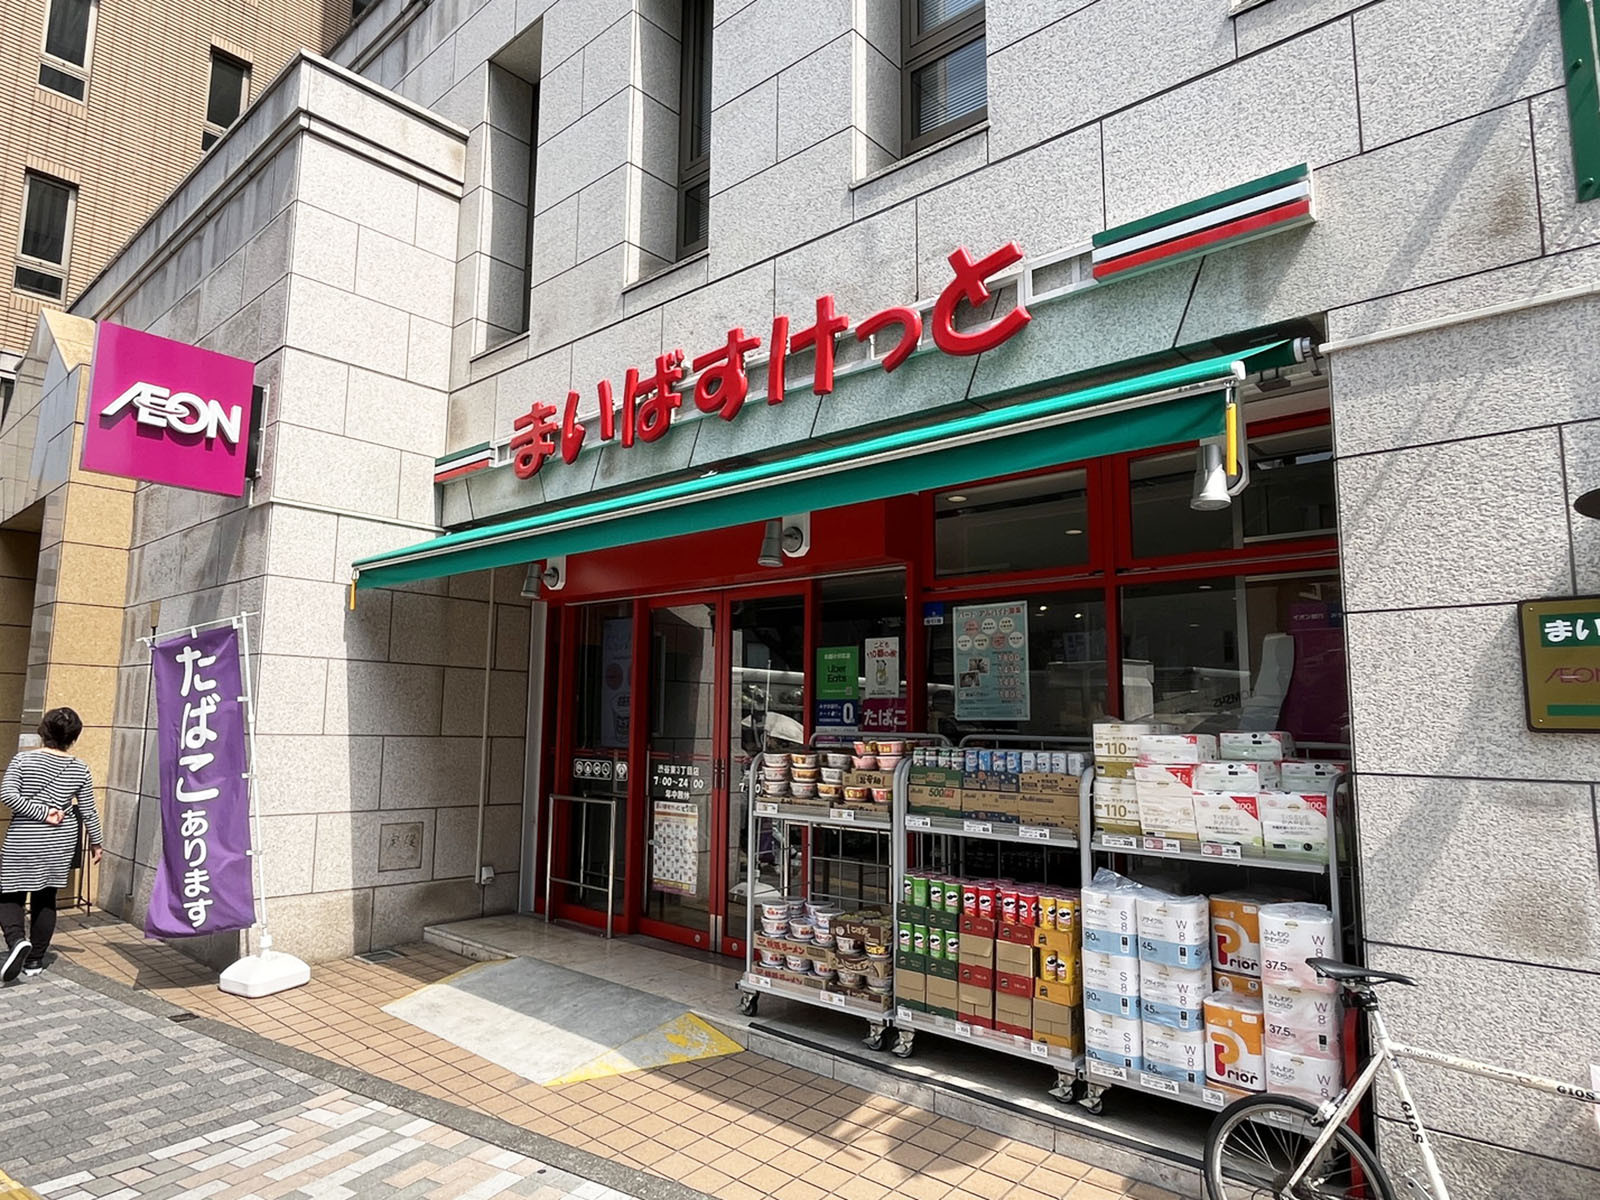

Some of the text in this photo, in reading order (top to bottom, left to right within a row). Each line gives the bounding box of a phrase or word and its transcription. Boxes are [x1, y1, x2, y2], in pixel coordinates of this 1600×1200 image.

[509, 241, 1031, 479] まいばすけっと
[101, 381, 242, 443] AEON
[827, 665, 846, 673] Uber
[864, 708, 907, 726] たばこ
[1104, 742, 1127, 755] 110
[1104, 804, 1127, 817] 110
[1120, 910, 1128, 921] S
[1121, 922, 1128, 931] 8
[1175, 920, 1187, 930] W
[1178, 932, 1186, 941] 8
[1311, 935, 1325, 946] W
[1316, 948, 1324, 959] 8
[1120, 971, 1128, 982] S
[1120, 983, 1128, 992] 8
[1177, 984, 1189, 993] W
[1179, 995, 1187, 1005] 8
[1314, 1002, 1328, 1013] W
[1318, 1015, 1326, 1025] 8
[1123, 1032, 1132, 1043] S
[1124, 1043, 1132, 1053] 8
[1184, 1045, 1197, 1056] W
[1187, 1057, 1195, 1067] 8
[1317, 1074, 1331, 1086] W
[1321, 1088, 1329, 1098] 8
[1556, 1085, 1596, 1101] GIOS
[1401, 1101, 1424, 1144] GIOS
